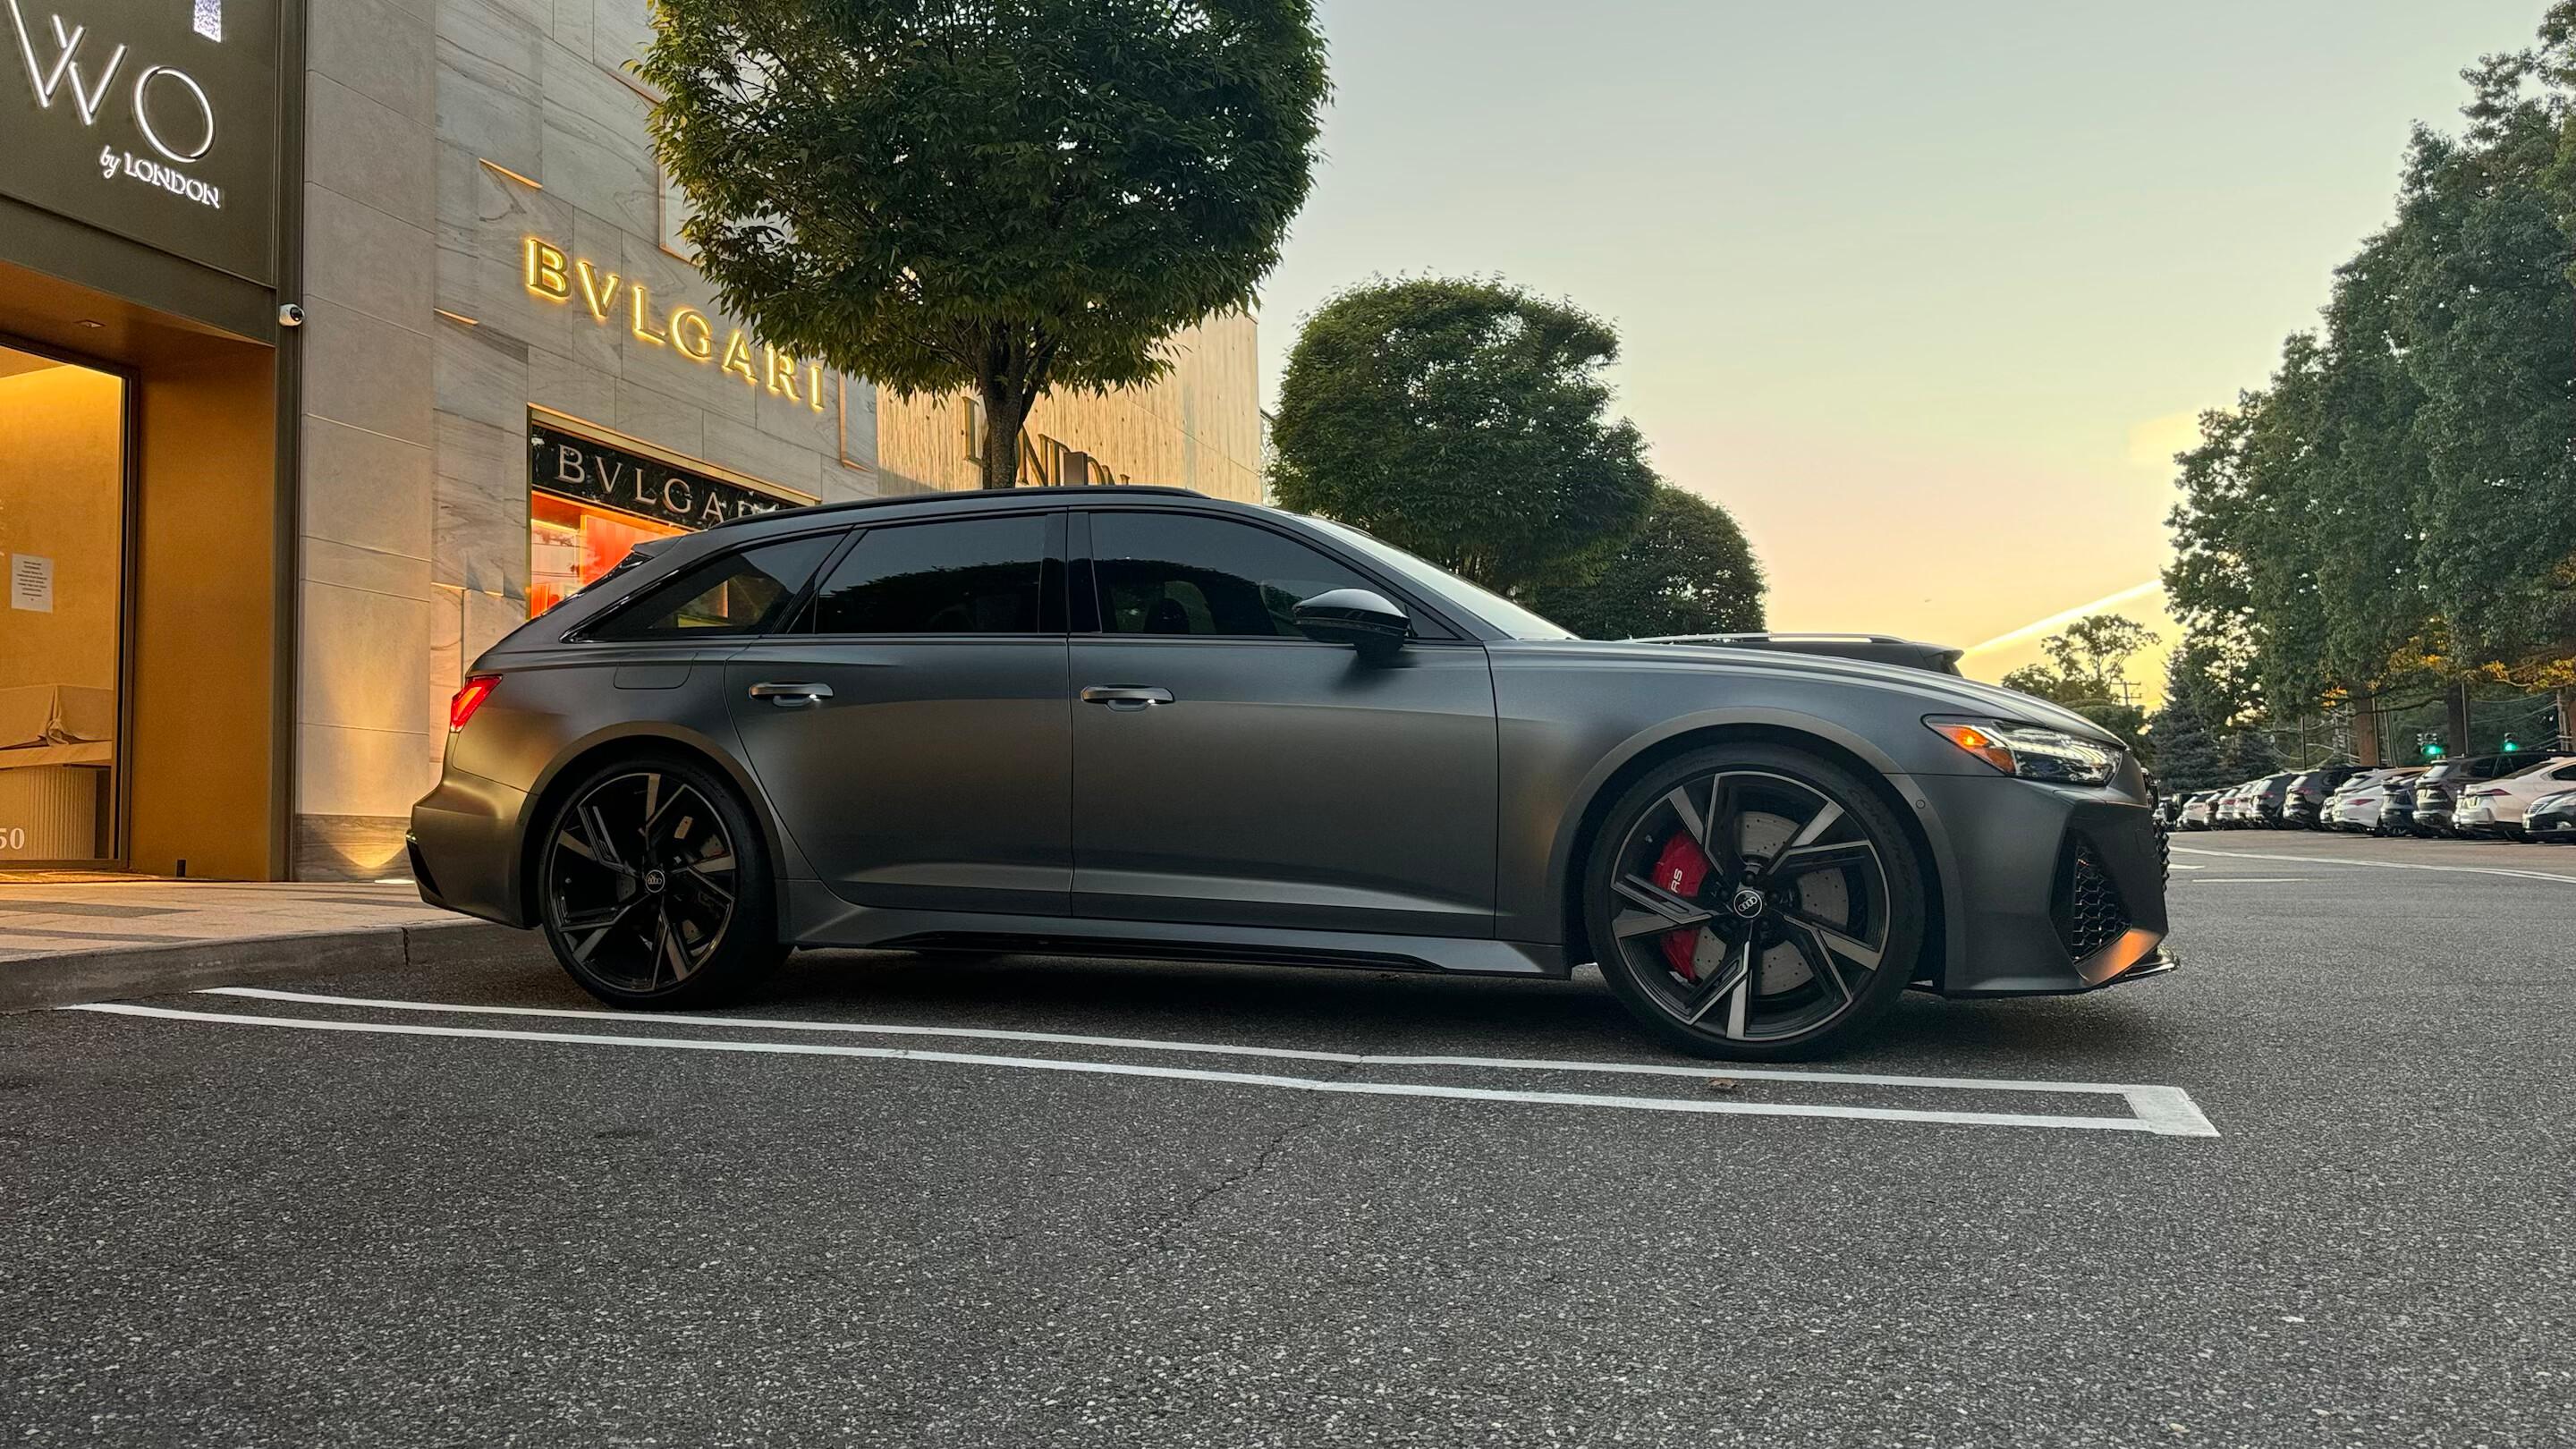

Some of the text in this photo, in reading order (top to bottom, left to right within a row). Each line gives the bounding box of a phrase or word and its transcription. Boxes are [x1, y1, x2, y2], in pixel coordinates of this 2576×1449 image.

[99, 145, 220, 209] by LONDON
[524, 236, 825, 411] BVLGARI
[1671, 868, 1683, 894] RS
